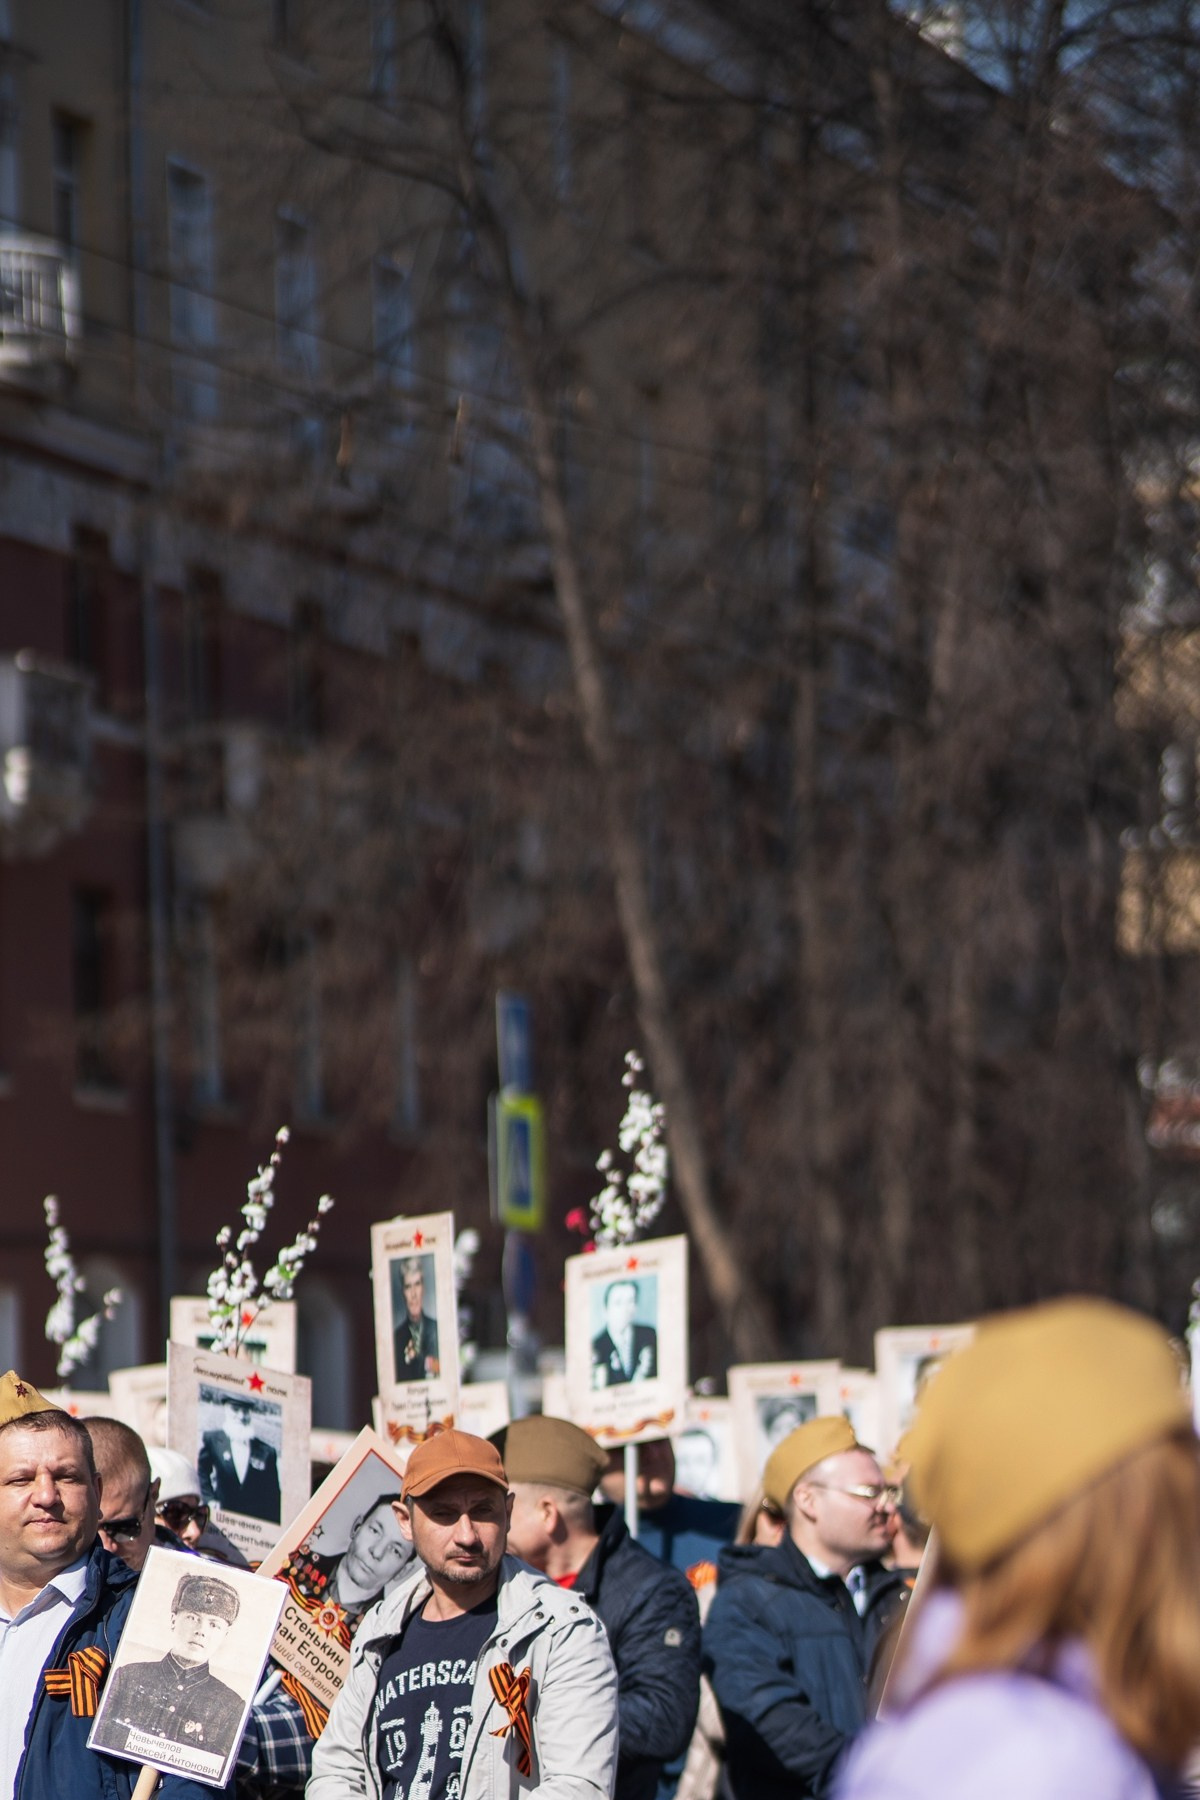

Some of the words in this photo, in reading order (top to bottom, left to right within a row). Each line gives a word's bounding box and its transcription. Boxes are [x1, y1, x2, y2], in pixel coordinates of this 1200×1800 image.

[215, 1512, 262, 1533] Шевченко
[284, 1606, 345, 1668] Стенькин
[293, 1661, 335, 1700] сержант
[125, 1742, 166, 1760] Алексей
[167, 1754, 220, 1777] Антонович
[130, 1731, 182, 1754] Чевычелов
